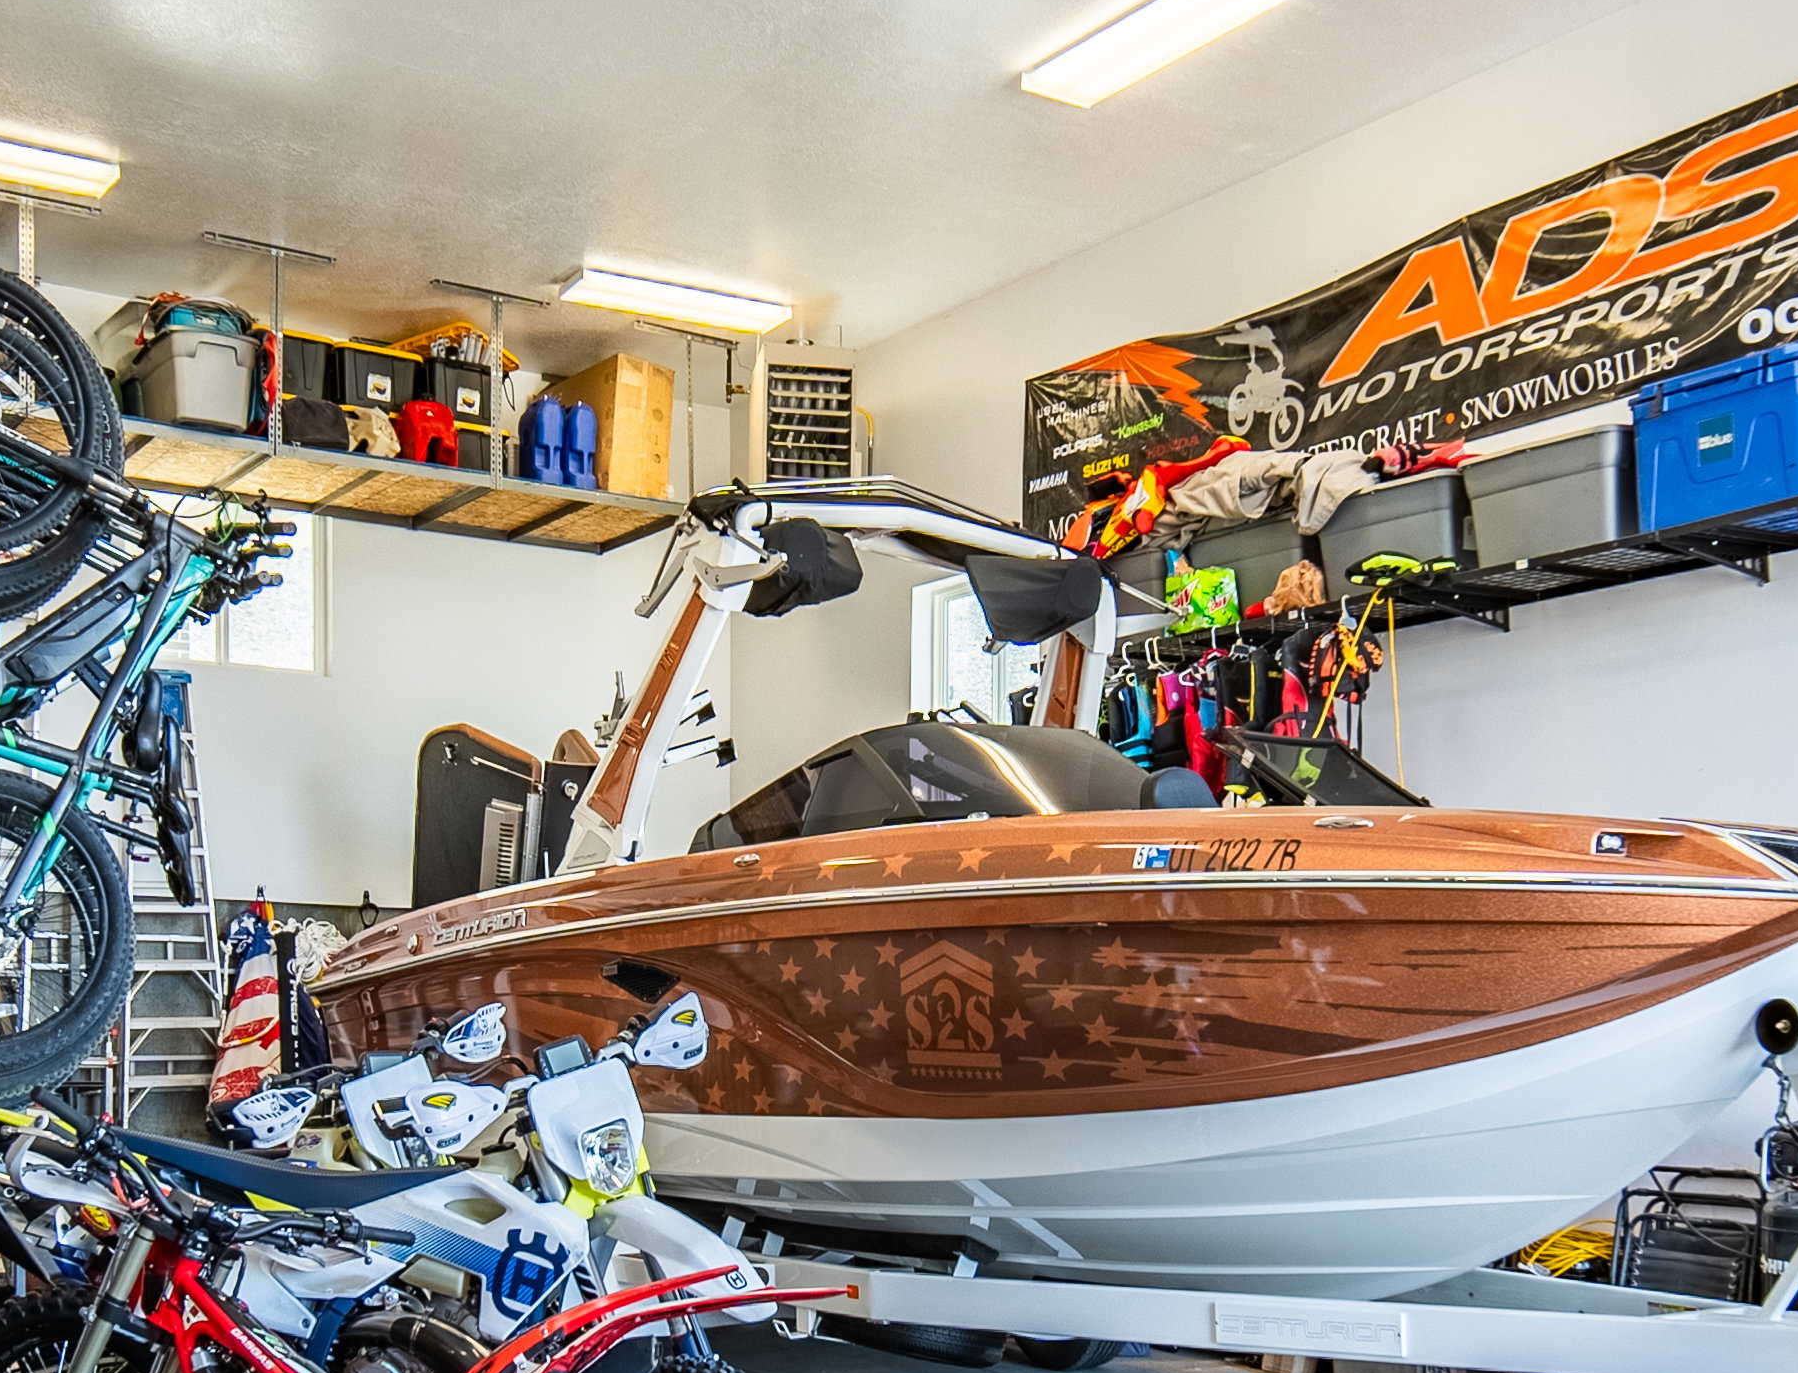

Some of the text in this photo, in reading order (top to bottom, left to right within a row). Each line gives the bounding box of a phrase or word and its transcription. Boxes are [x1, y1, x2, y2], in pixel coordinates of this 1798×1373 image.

[1460, 336, 1681, 431] SNOWMOBILES
[1052, 433, 1104, 460] POLARIS
[1028, 469, 1069, 495] YAMAHA
[432, 907, 528, 947] CENTURION
[230, 1327, 276, 1371] GASGAS
